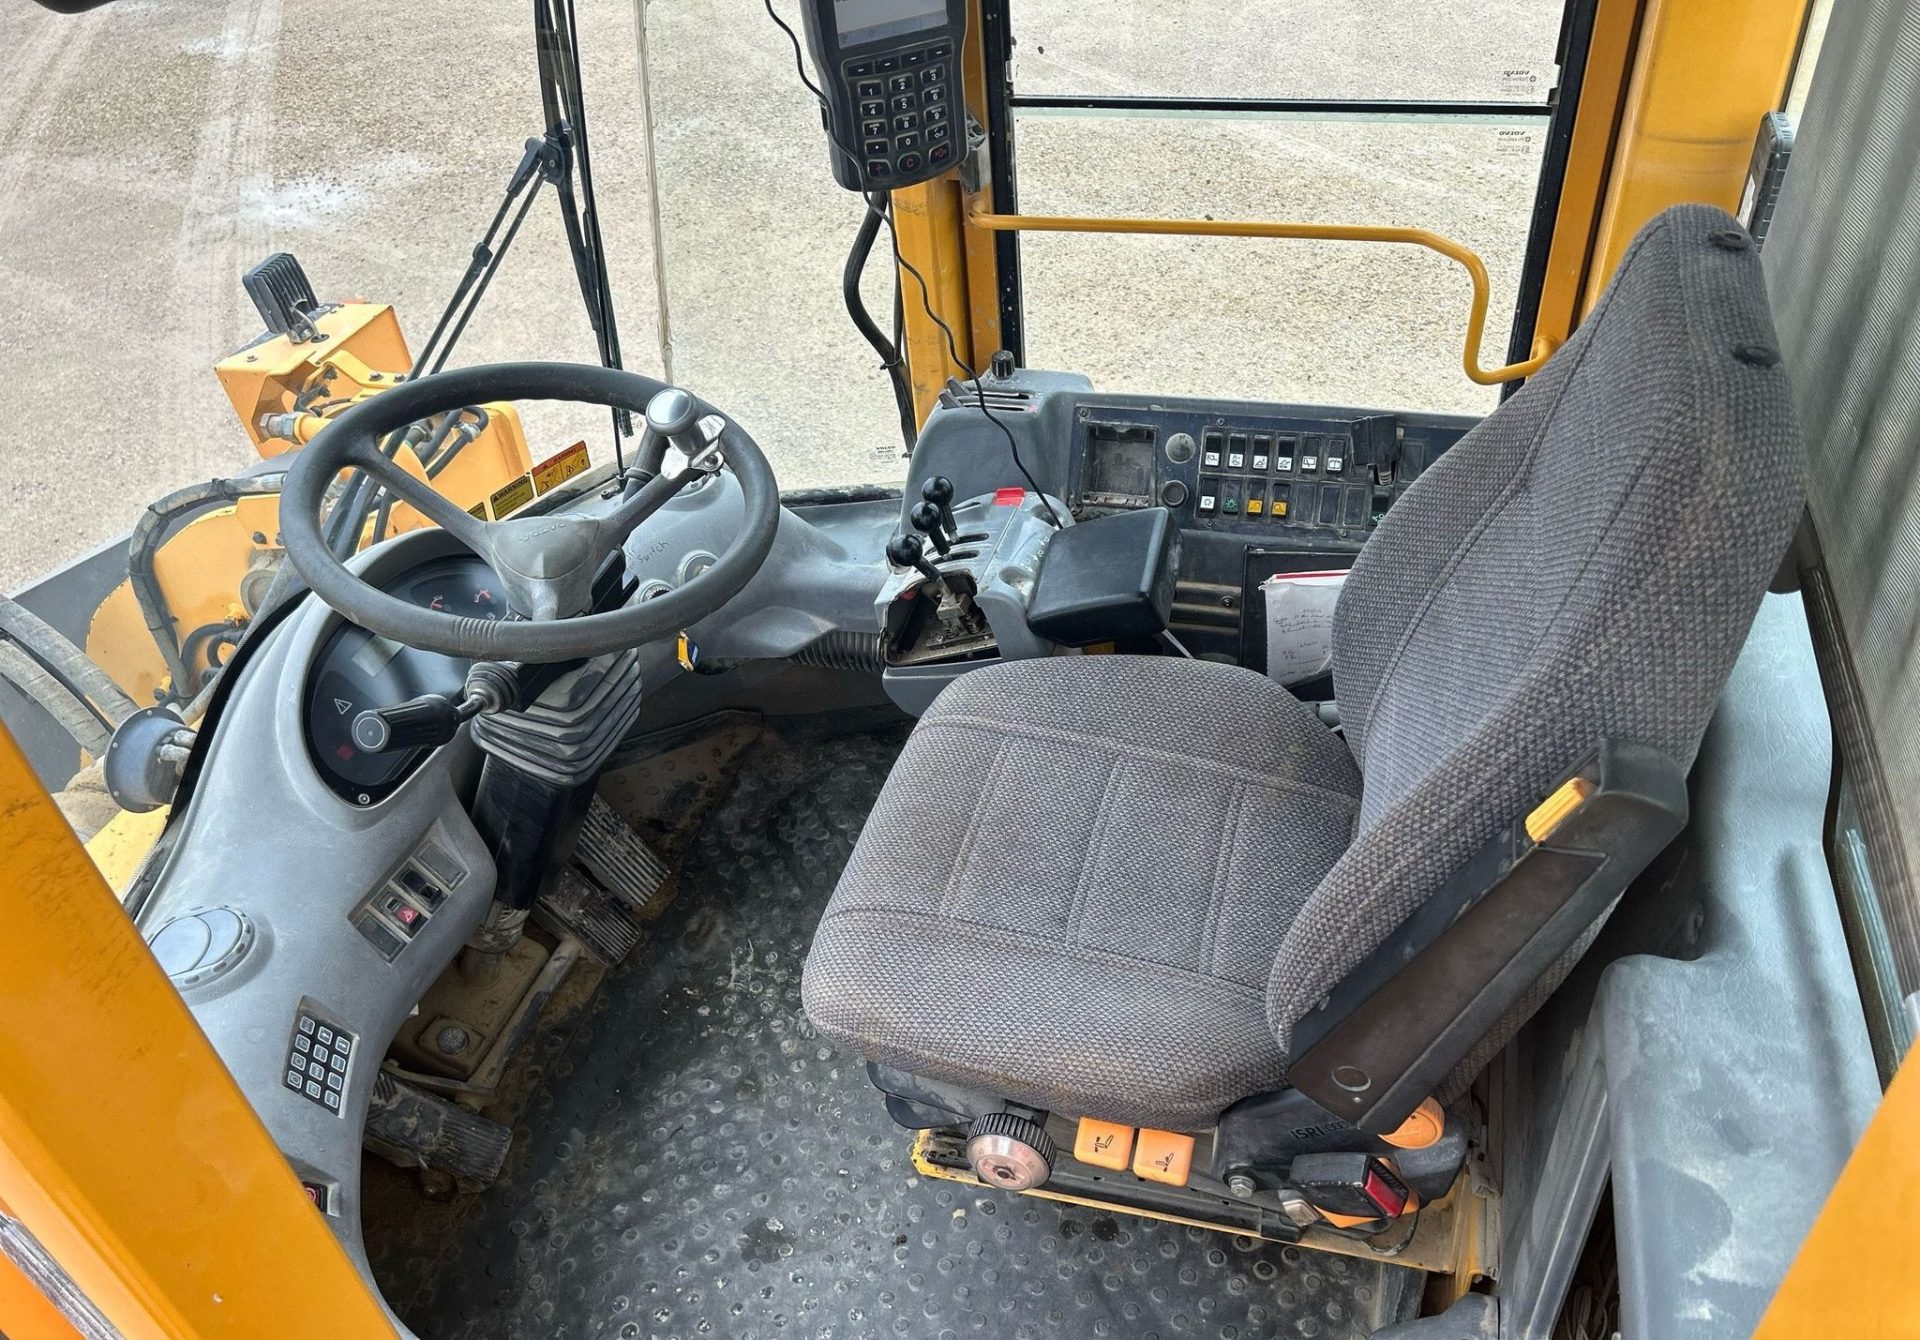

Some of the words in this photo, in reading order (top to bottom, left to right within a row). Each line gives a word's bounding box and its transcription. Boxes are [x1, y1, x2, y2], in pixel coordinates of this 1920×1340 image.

[931, 73, 936, 81] 3
[900, 82, 906, 90] 2
[868, 88, 873, 96] 1
[902, 101, 907, 109] 5
[870, 107, 876, 115] 4
[934, 112, 939, 120] 9
[873, 127, 878, 135] 7
[905, 138, 911, 146] 0
[906, 158, 914, 168] C
[498, 476, 529, 499] WARNING
[1290, 1125, 1325, 1140] ISRI
